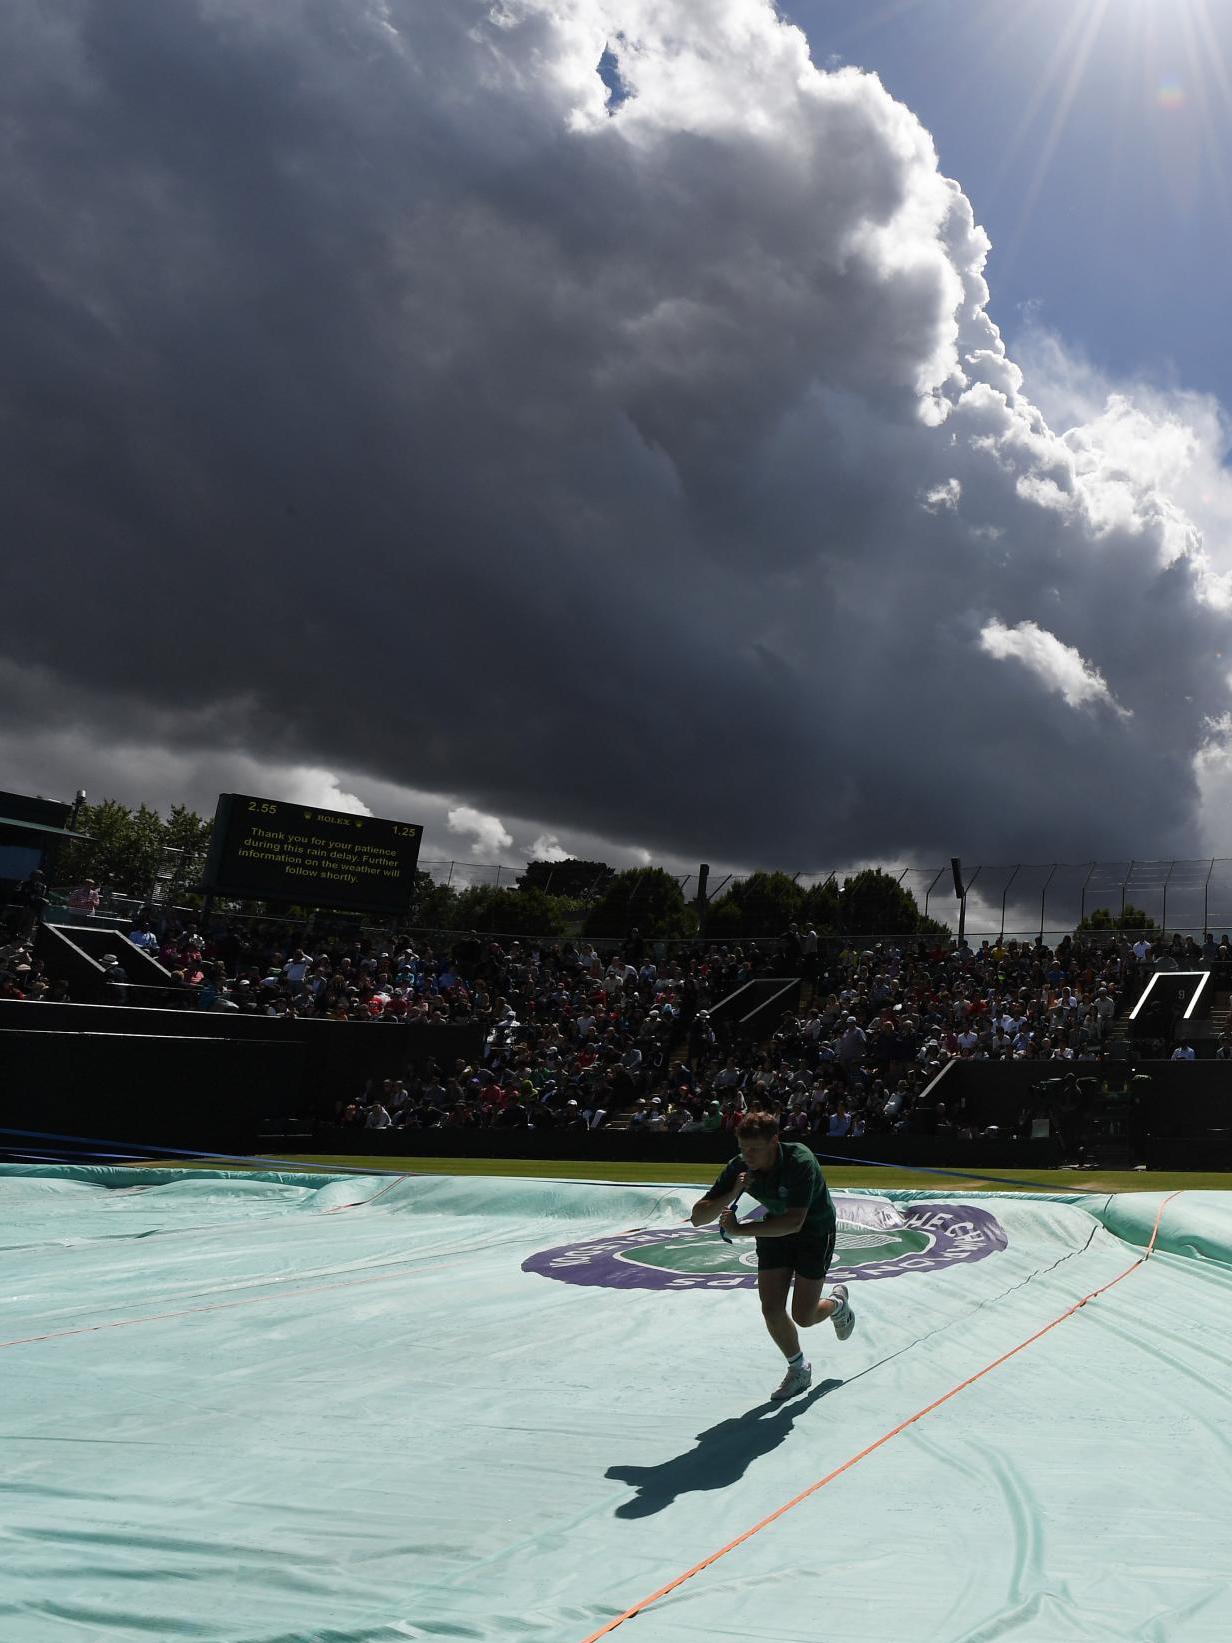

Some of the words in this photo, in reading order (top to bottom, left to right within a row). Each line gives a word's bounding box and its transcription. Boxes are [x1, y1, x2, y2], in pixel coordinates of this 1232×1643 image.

[248, 801, 277, 814] 2.55
[317, 814, 350, 826] ROLEX
[392, 825, 416, 837] 1.25
[251, 827, 285, 840] Thank
[288, 832, 308, 845] you
[311, 836, 326, 846] for
[329, 840, 352, 852] your
[354, 843, 397, 857] patience
[244, 838, 281, 852] during
[284, 842, 304, 853] this
[307, 847, 327, 857] rain
[330, 850, 359, 863] delay.
[362, 854, 399, 867] Further
[238, 848, 302, 864] information
[305, 857, 319, 866] on
[321, 858, 338, 869] the
[341, 862, 380, 875] weather
[383, 866, 400, 877] will
[285, 866, 318, 878] follow
[320, 870, 359, 883] shortly.
[899, 1212, 953, 1230] HE
